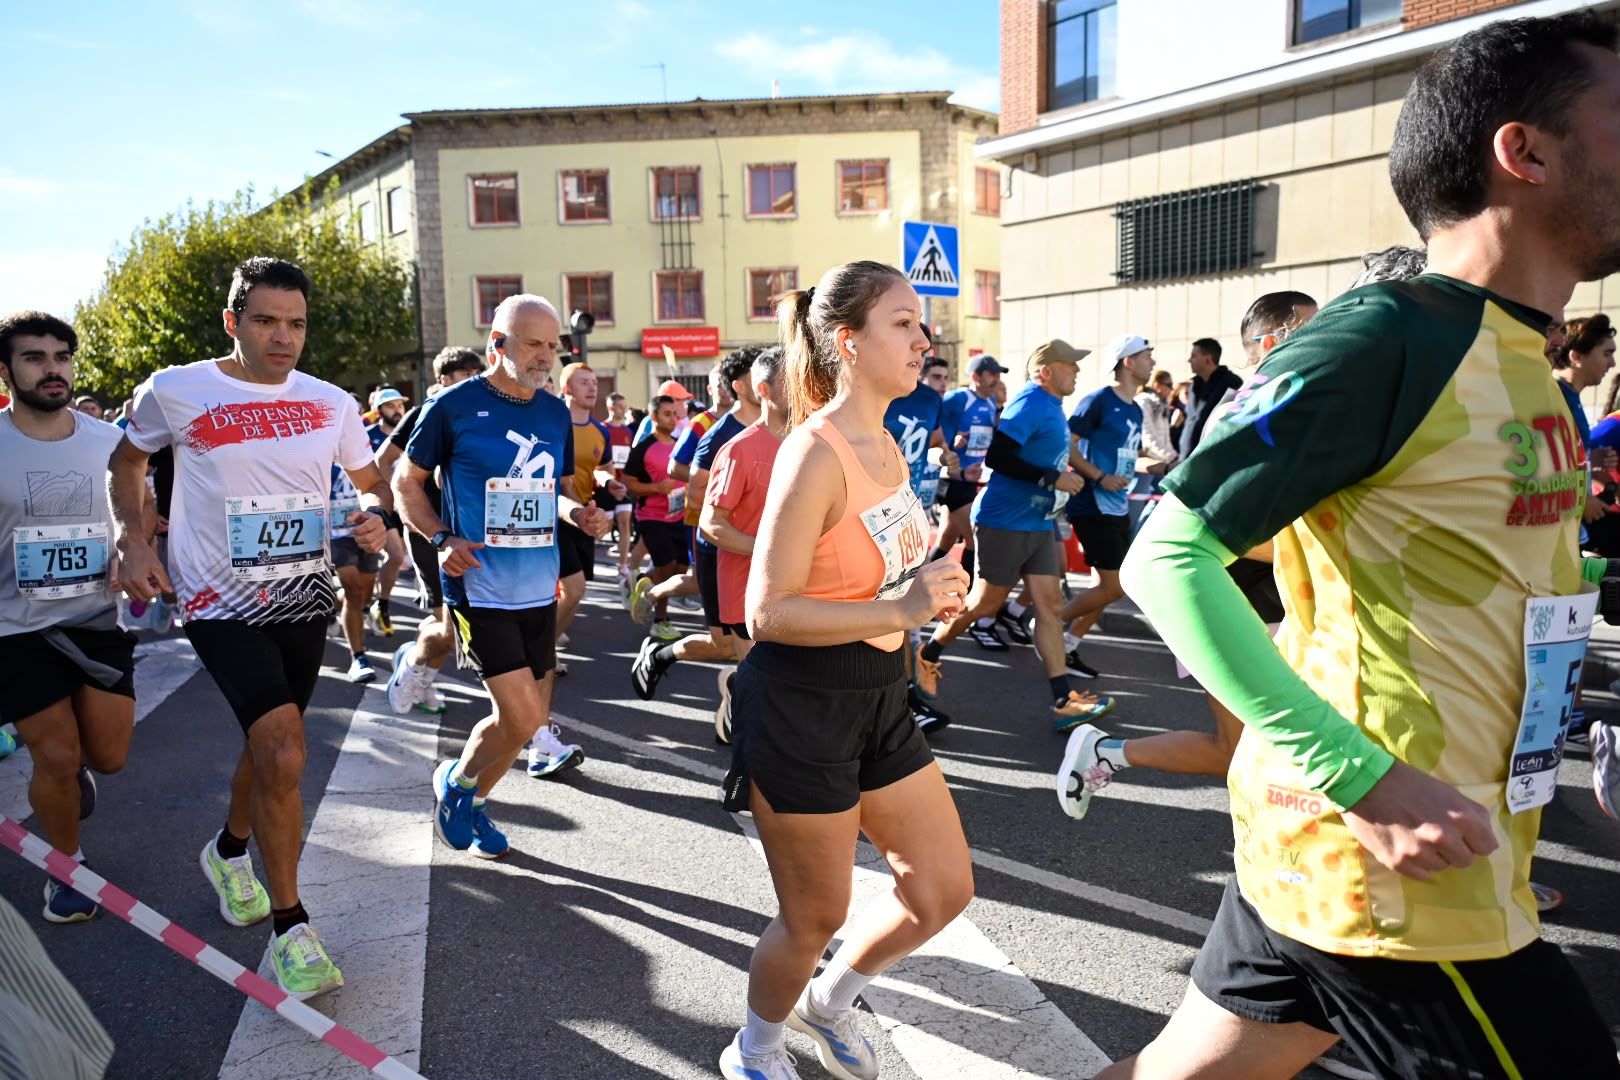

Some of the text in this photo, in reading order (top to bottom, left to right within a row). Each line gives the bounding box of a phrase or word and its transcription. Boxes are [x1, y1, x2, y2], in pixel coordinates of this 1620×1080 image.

[204, 402, 228, 414] LA
[210, 406, 313, 429] DESPENSA
[241, 419, 313, 441] DE FER
[251, 500, 257, 508] k
[511, 500, 539, 521] 451
[1506, 511, 1560, 526] DE ARRIBA
[258, 519, 304, 548] 422
[897, 518, 924, 569] 1814
[42, 546, 87, 573] 763
[270, 585, 315, 607] León
[1568, 606, 1577, 625] k
[1267, 788, 1321, 815] ZAPICO
